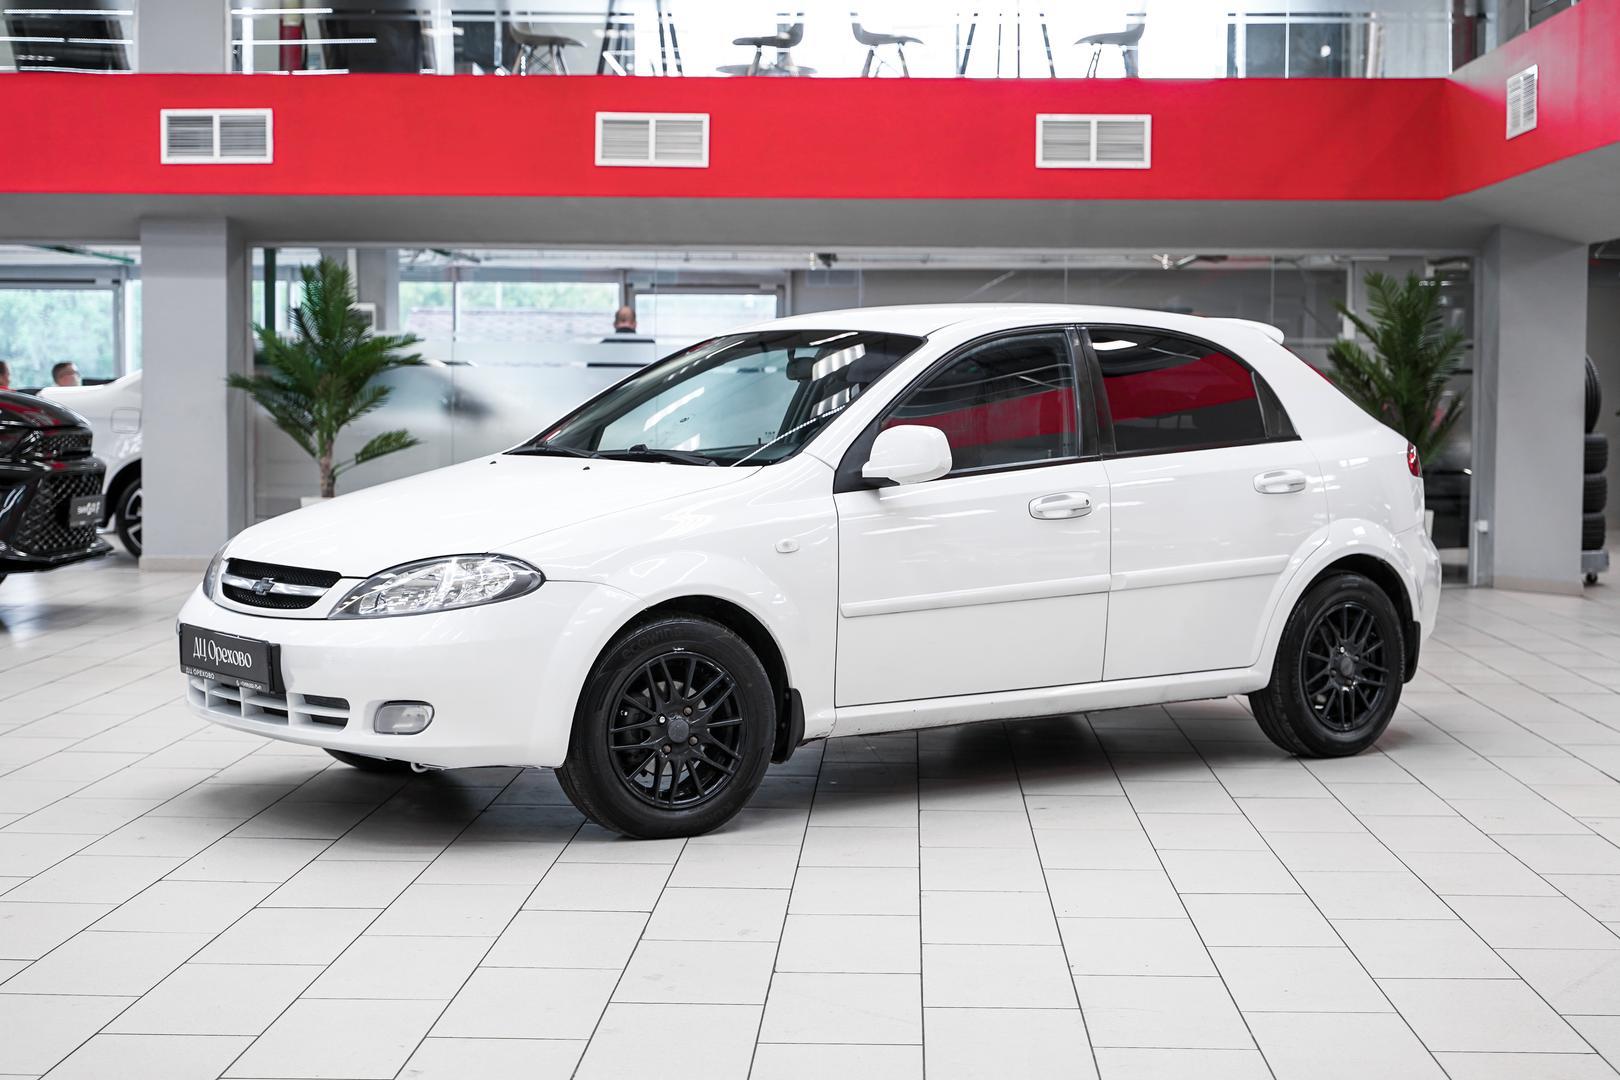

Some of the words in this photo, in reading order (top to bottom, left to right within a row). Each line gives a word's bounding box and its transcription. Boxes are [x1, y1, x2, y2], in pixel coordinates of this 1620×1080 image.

[193, 636, 207, 662] ДЦ
[208, 639, 252, 668] Орехово
[193, 668, 215, 680] ОРЕХОВО
